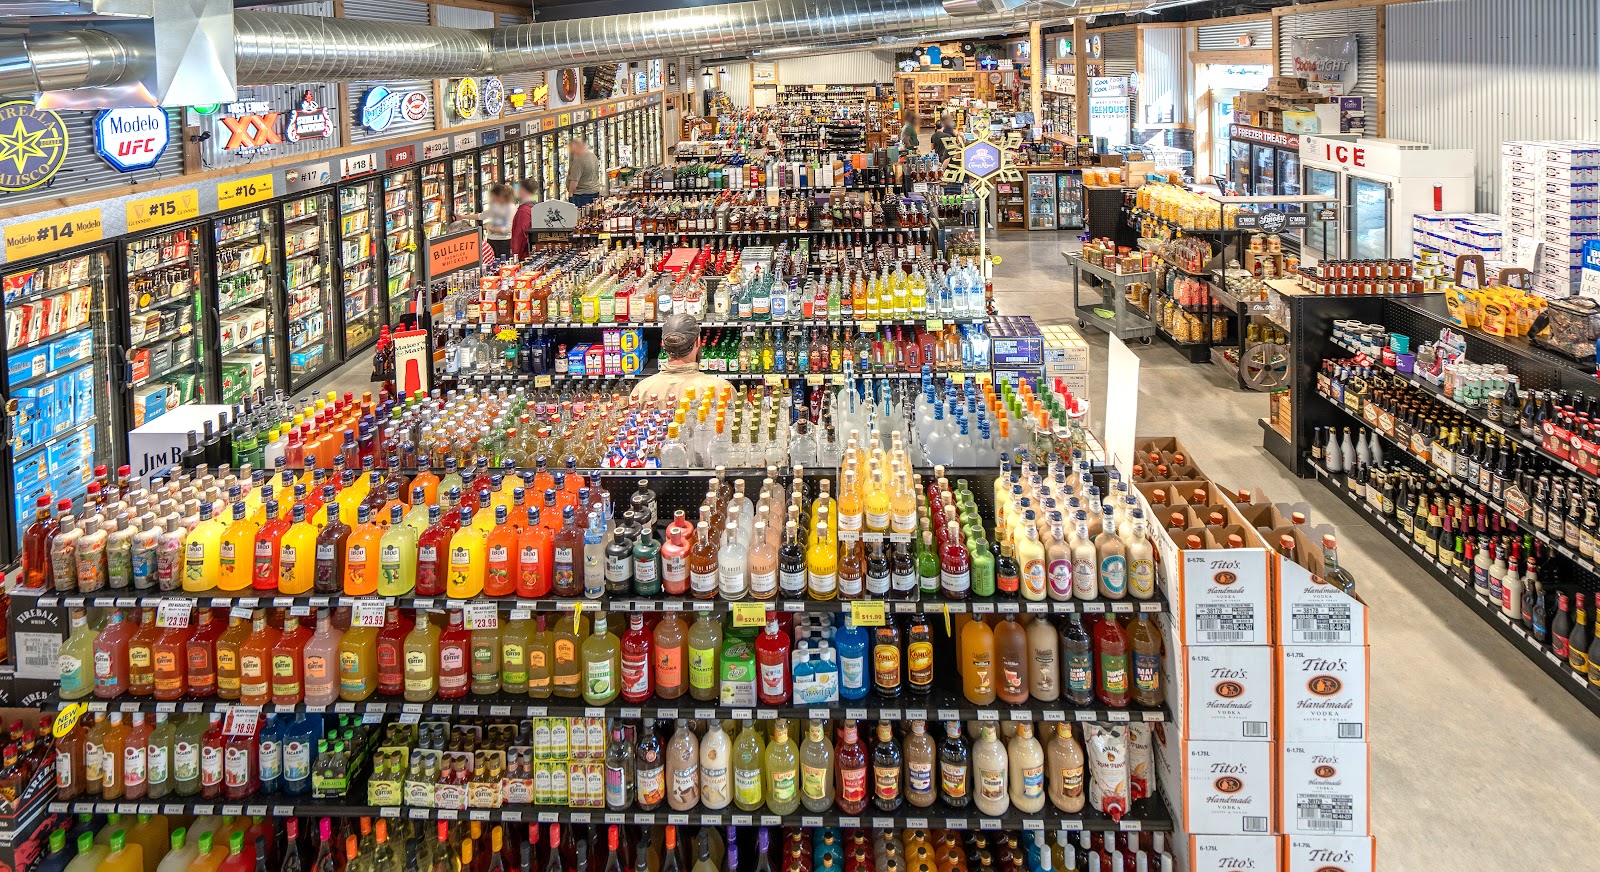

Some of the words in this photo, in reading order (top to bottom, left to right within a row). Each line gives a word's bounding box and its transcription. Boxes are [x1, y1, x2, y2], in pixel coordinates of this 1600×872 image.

[1295, 56, 1317, 71] Coors
[1317, 58, 1349, 72] LIGHT
[110, 115, 159, 134] Modelo
[222, 112, 282, 150] XX
[1238, 128, 1262, 140] FREEZER
[1264, 132, 1287, 145] TREATS
[118, 138, 155, 157] UFC
[1326, 144, 1366, 167] ICE
[352, 159, 366, 169] #18
[395, 151, 408, 162] #19
[301, 171, 317, 182] #17
[235, 184, 257, 198] #16
[148, 200, 176, 217] #15
[7, 234, 36, 248] Modelo
[36, 222, 74, 242] #14
[76, 219, 101, 232] Modelo
[433, 241, 475, 260] BULLEIT
[442, 256, 469, 267] WHISKEY
[139, 452, 167, 480] JIM
[16, 609, 57, 625] FIREBALL
[166, 616, 188, 626] $23.99
[362, 615, 383, 625] $23.99
[475, 619, 497, 628] $23.99
[22, 691, 48, 706] FIREB
[1206, 700, 1252, 709] Handmade
[1296, 698, 1353, 709] Handmade
[57, 708, 78, 724] NEW
[56, 716, 77, 733] ITEM
[1206, 795, 1252, 804] Handmade
